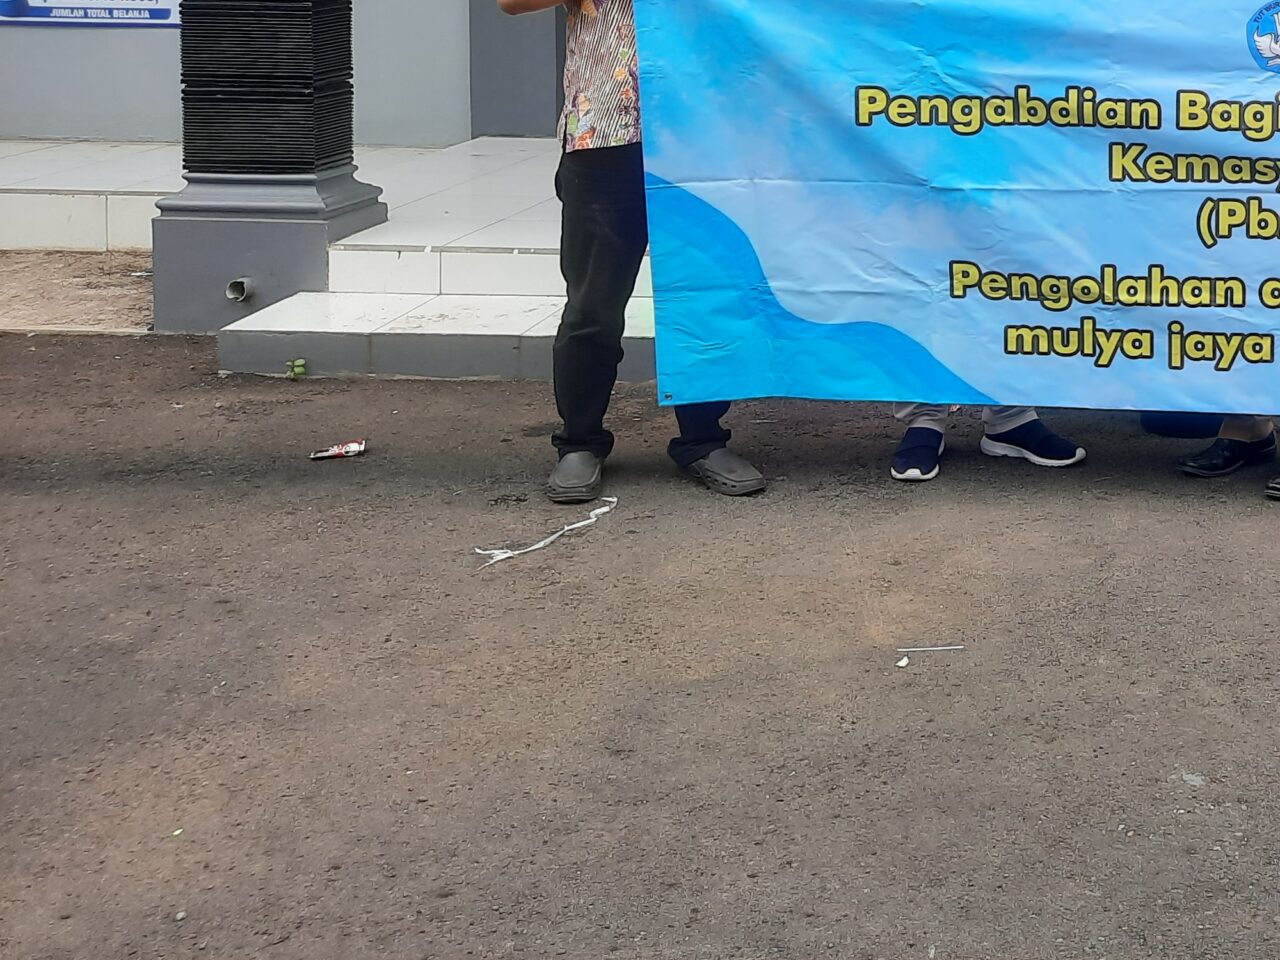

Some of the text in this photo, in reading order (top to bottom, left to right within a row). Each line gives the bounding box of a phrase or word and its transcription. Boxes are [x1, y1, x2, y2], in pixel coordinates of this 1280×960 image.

[50, 8, 151, 19] JUMLAH TOTAL BELANJA
[1254, 11, 1266, 24] TUT
[855, 85, 1162, 136] Pengabdian
[948, 260, 1246, 312] Pengolahan
[1004, 315, 1155, 368] mulya
[1168, 320, 1275, 371] jaya
